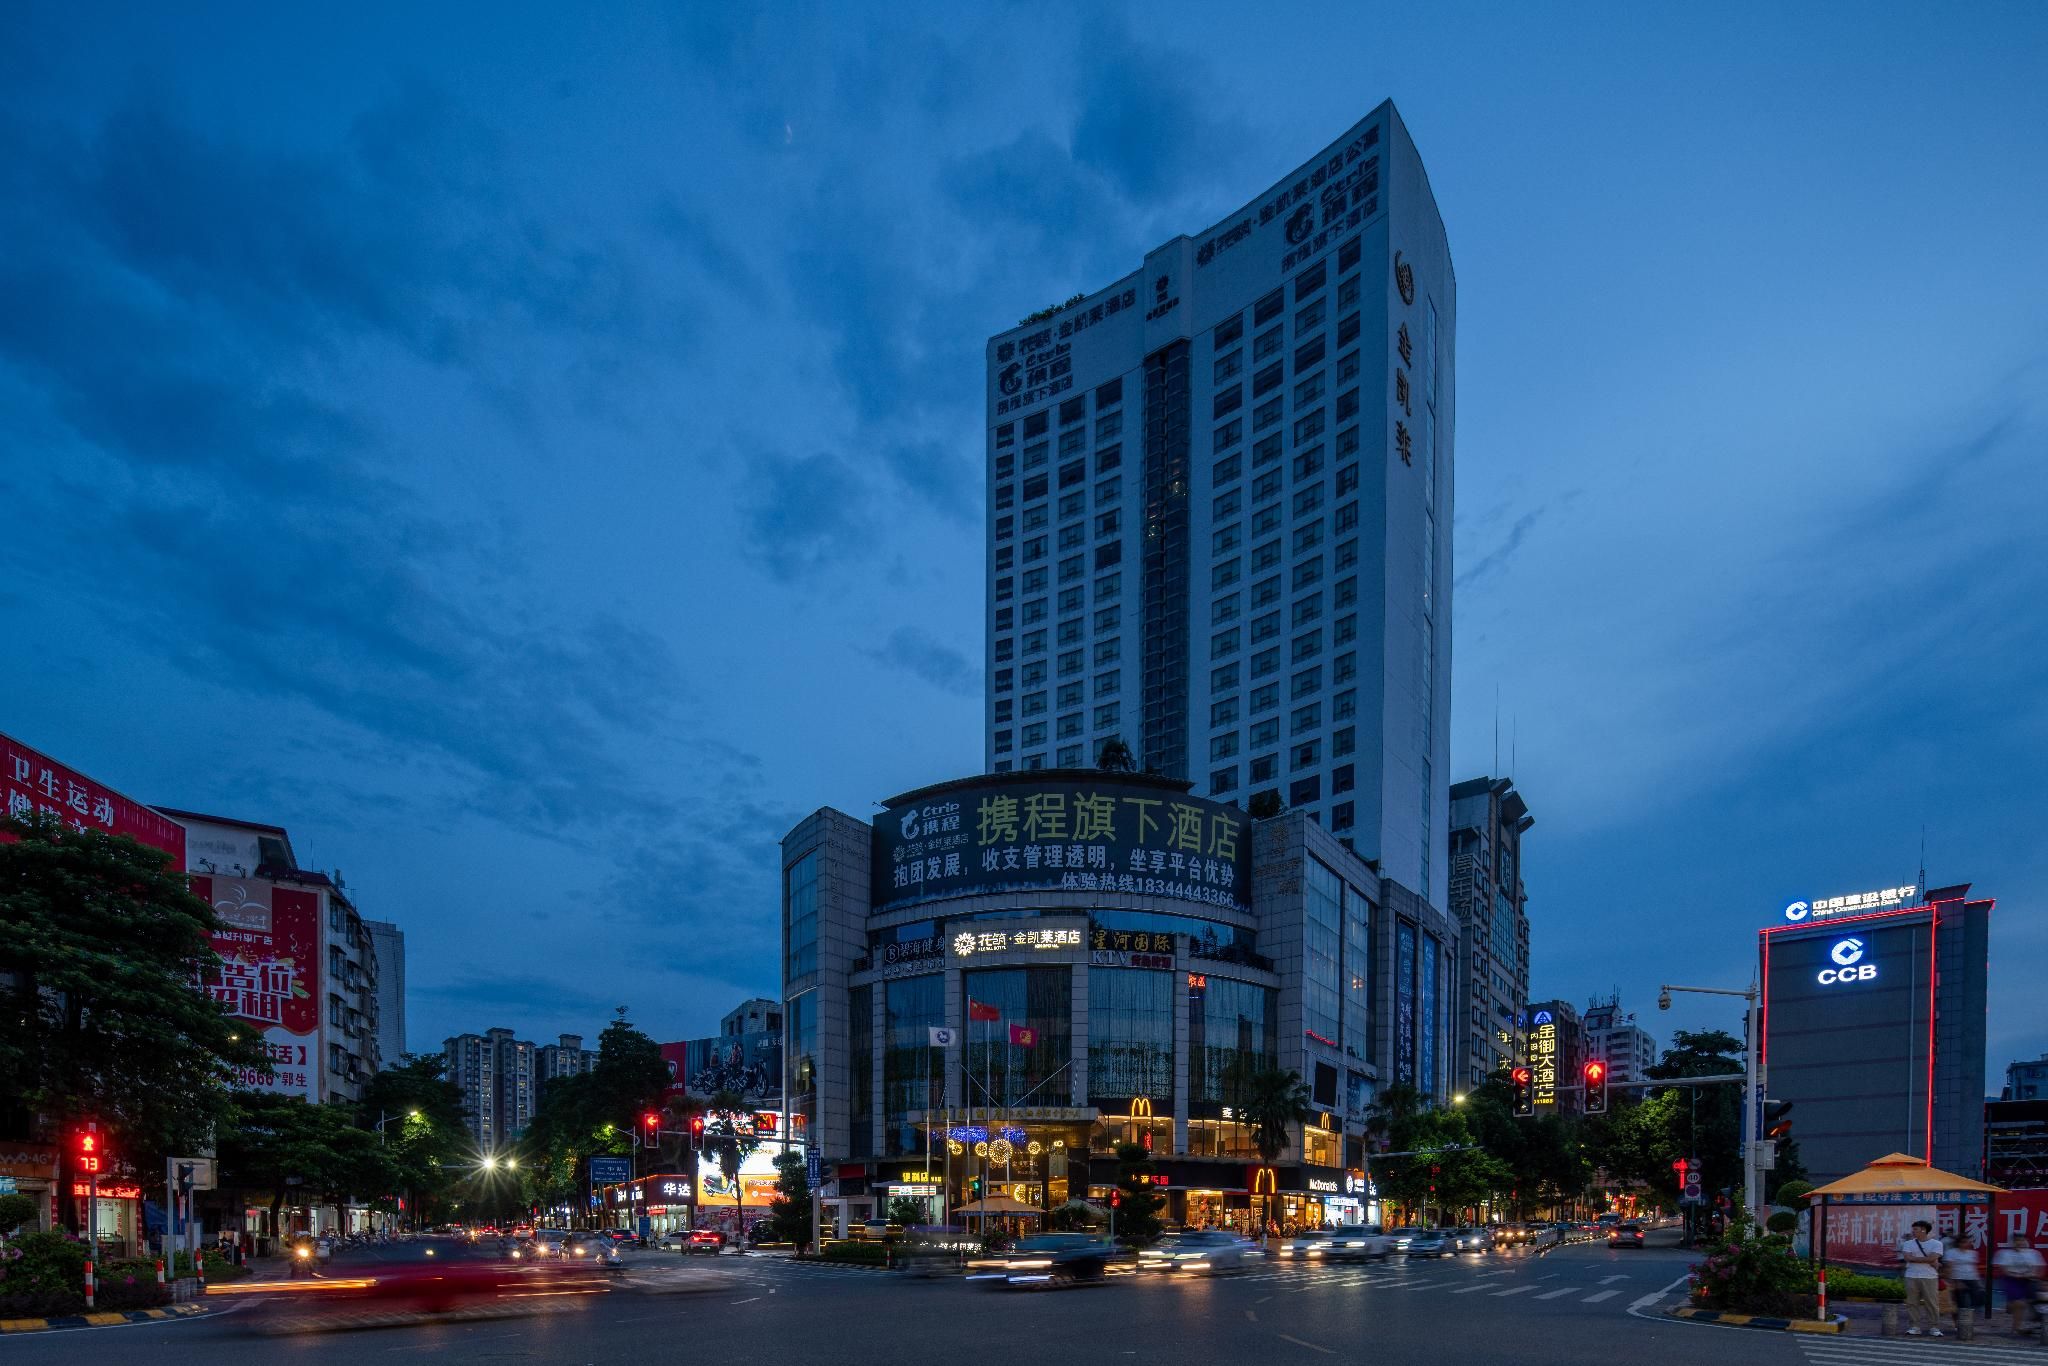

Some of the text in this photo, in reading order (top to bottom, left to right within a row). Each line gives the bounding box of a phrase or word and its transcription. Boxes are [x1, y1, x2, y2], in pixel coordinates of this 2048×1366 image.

[8, 753, 114, 827] 卫生运动
[922, 802, 961, 817] Ctrip
[922, 815, 961, 836] 携程
[976, 792, 1241, 863] 携程旗下酒店
[1130, 848, 1235, 888] 坐享平台优势
[1812, 885, 1916, 910] 中国建设银行
[1094, 930, 1171, 952] 星河国际
[1092, 950, 1129, 964] KTV
[1818, 965, 1877, 985] CCB
[1539, 1024, 1556, 1097] 金御大酒店
[281, 1072, 308, 1087] 郭生
[80, 1157, 98, 1171] 73
[663, 1182, 691, 1197] 华达
